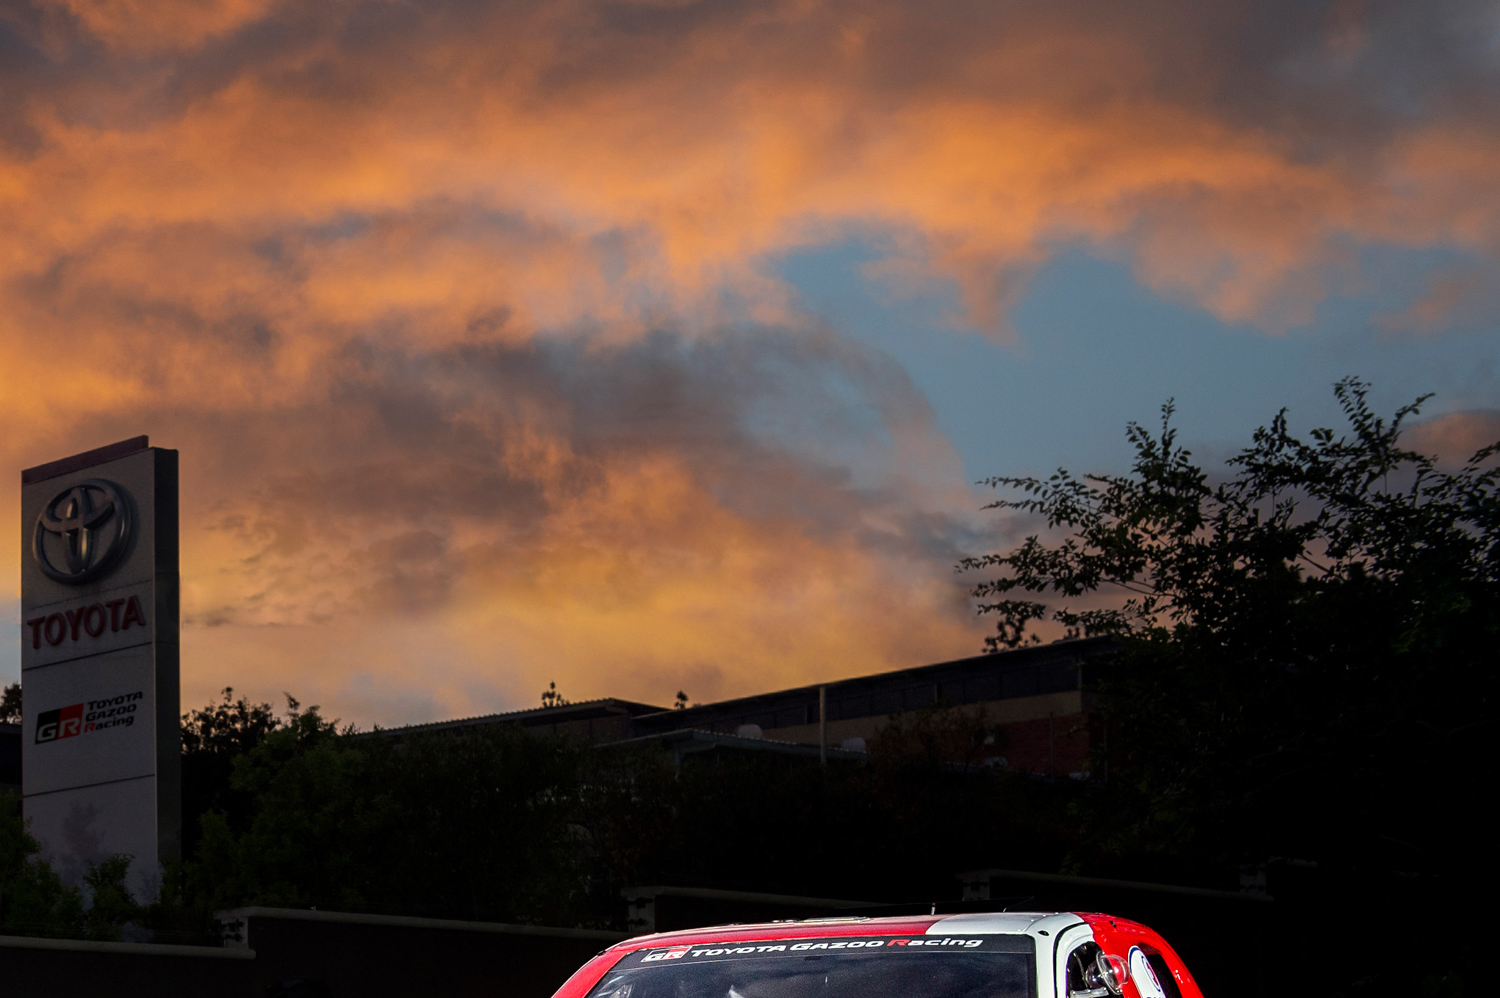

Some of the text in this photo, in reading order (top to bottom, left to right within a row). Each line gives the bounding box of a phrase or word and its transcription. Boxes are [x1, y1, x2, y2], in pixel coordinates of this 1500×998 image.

[27, 594, 146, 650] TOYOTA
[87, 691, 143, 711] TOYOTA
[85, 703, 138, 722] GAZOO
[84, 715, 134, 733] Racing
[691, 945, 786, 957] TOYOTA
[790, 940, 885, 951] GAZOO
[887, 938, 984, 949] Racing
